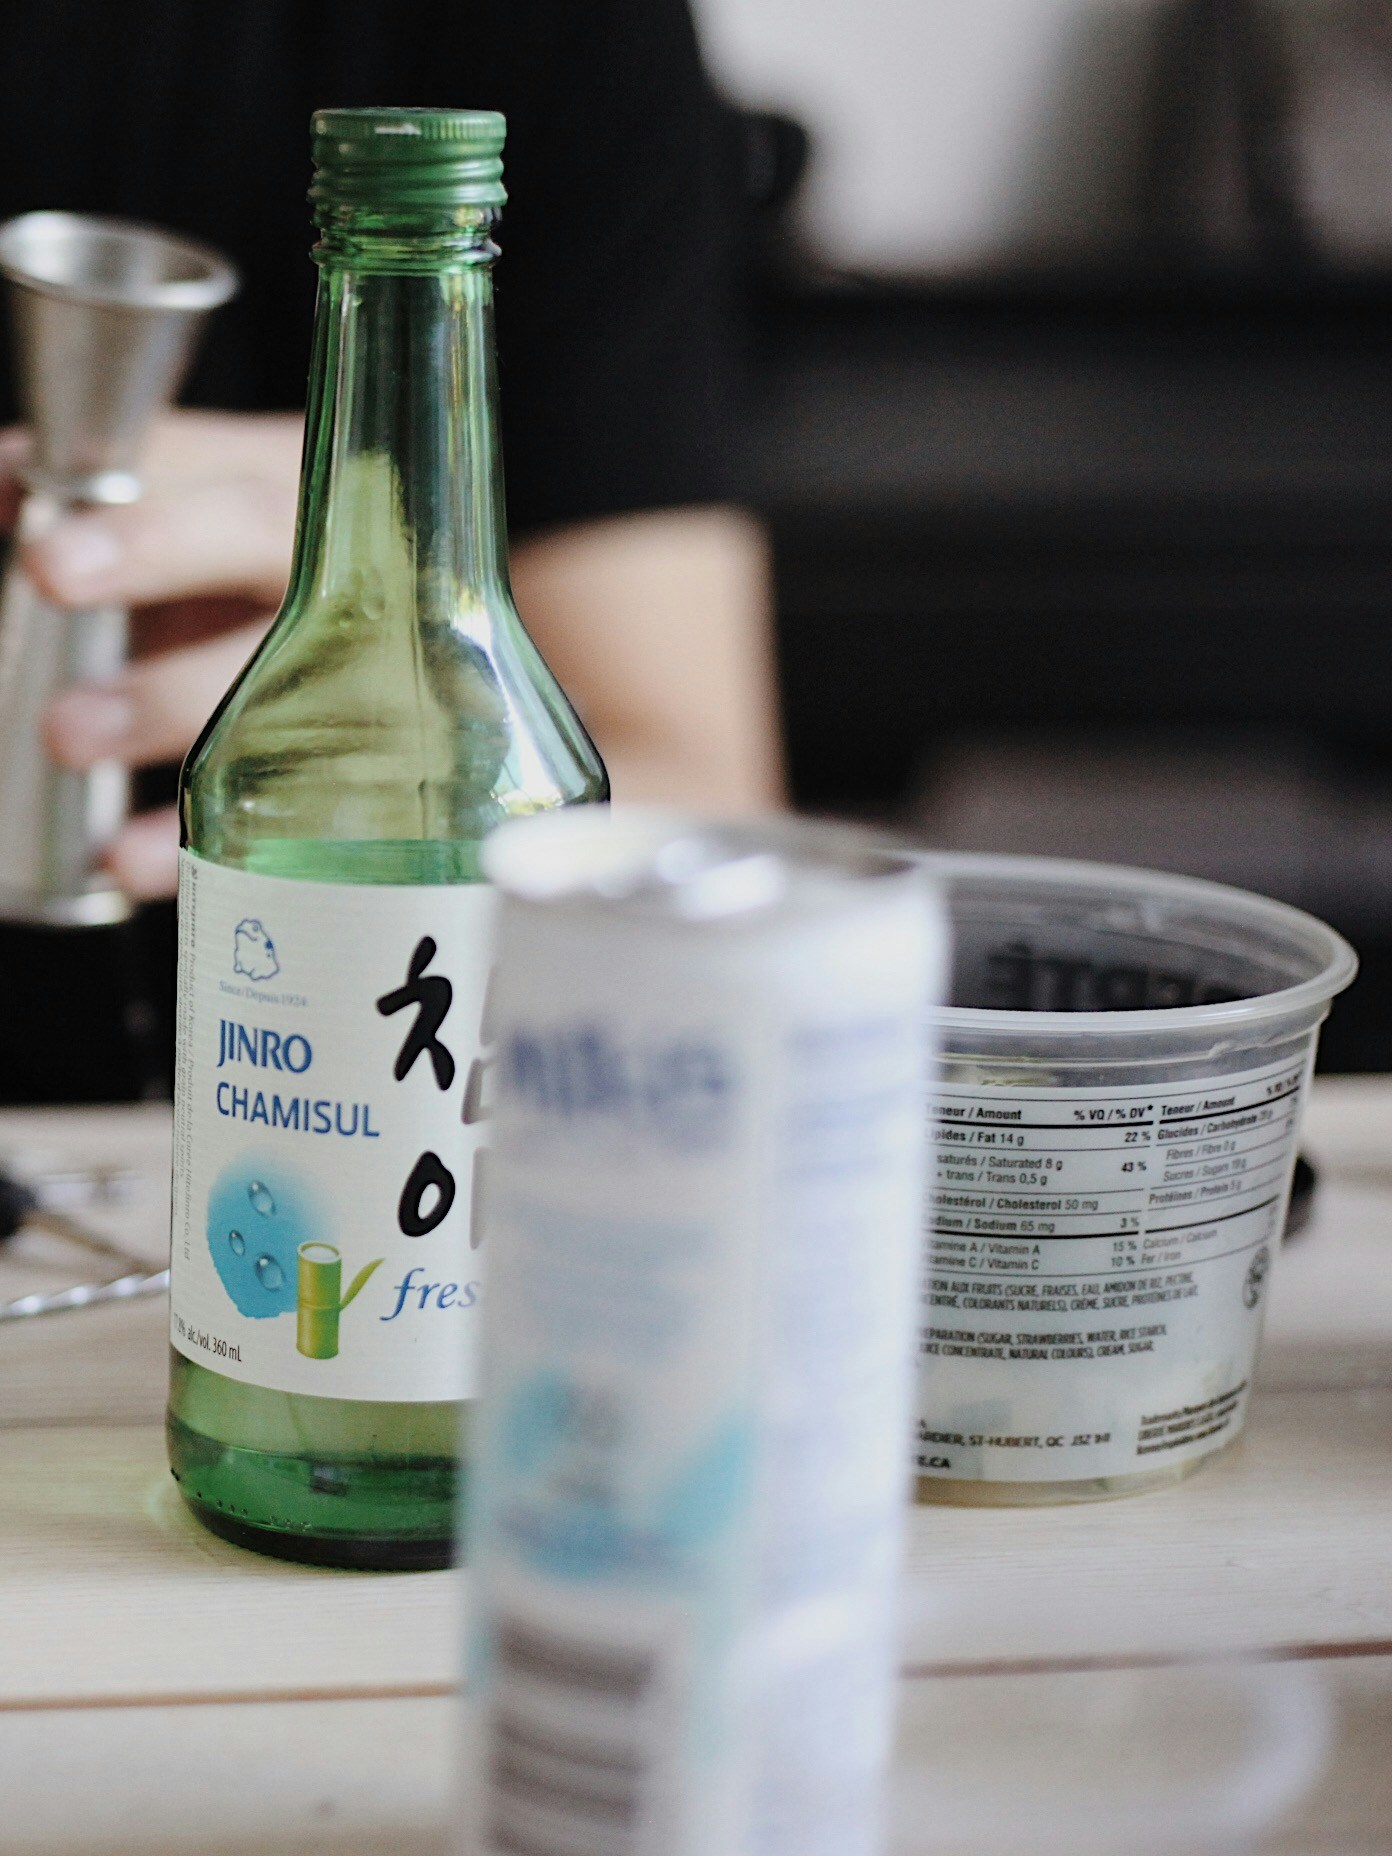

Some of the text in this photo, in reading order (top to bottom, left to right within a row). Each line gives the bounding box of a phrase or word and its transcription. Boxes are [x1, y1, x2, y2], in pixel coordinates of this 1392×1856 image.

[216, 1018, 313, 1074] JINRO
[216, 1081, 381, 1138] CHAMISUL
[927, 1103, 965, 1117] eneur
[977, 1107, 1022, 1120] Amount
[1074, 1110, 1085, 1120] %
[1089, 1109, 1105, 1120] VQ
[1116, 1109, 1126, 1118] %
[1161, 1104, 1195, 1116] Teneur
[1204, 1096, 1236, 1110] Amount
[978, 1132, 996, 1143] Fat
[1001, 1134, 1014, 1144] 14
[1018, 1136, 1024, 1146] g
[1125, 1131, 1150, 1142] 22 %
[1158, 1126, 1198, 1140] Glucides
[1166, 1148, 1194, 1160] Fibres
[936, 1154, 977, 1166] saturés
[988, 1156, 1042, 1169] Saturated
[1056, 1160, 1063, 1171] g
[1122, 1161, 1146, 1172] 43 %
[946, 1170, 974, 1182] trans
[986, 1172, 1016, 1184] Trans
[1019, 1172, 1038, 1185] 0,5
[1040, 1176, 1048, 1186] g
[926, 1193, 986, 1208] holestérol
[996, 1198, 1061, 1210] Cholesterol
[1064, 1199, 1078, 1210] 50
[1082, 1200, 1098, 1212] mg
[974, 1218, 1017, 1231] Sodium
[1038, 1221, 1056, 1233] mg
[1120, 1217, 1140, 1228] 3 %
[927, 1240, 966, 1252] tamine
[970, 1242, 978, 1252] A
[988, 1243, 1029, 1254] Vitamin
[1032, 1245, 1040, 1255] A
[1114, 1240, 1138, 1252] 15 %
[926, 1254, 966, 1266] tamine
[968, 1256, 976, 1267] C
[987, 1258, 1028, 1270] Vitamin
[1031, 1260, 1039, 1270] C
[1112, 1256, 1135, 1268] 10 %
[380, 1266, 482, 1321] fres
[212, 1336, 227, 1357] 360
[228, 1344, 242, 1362] mL
